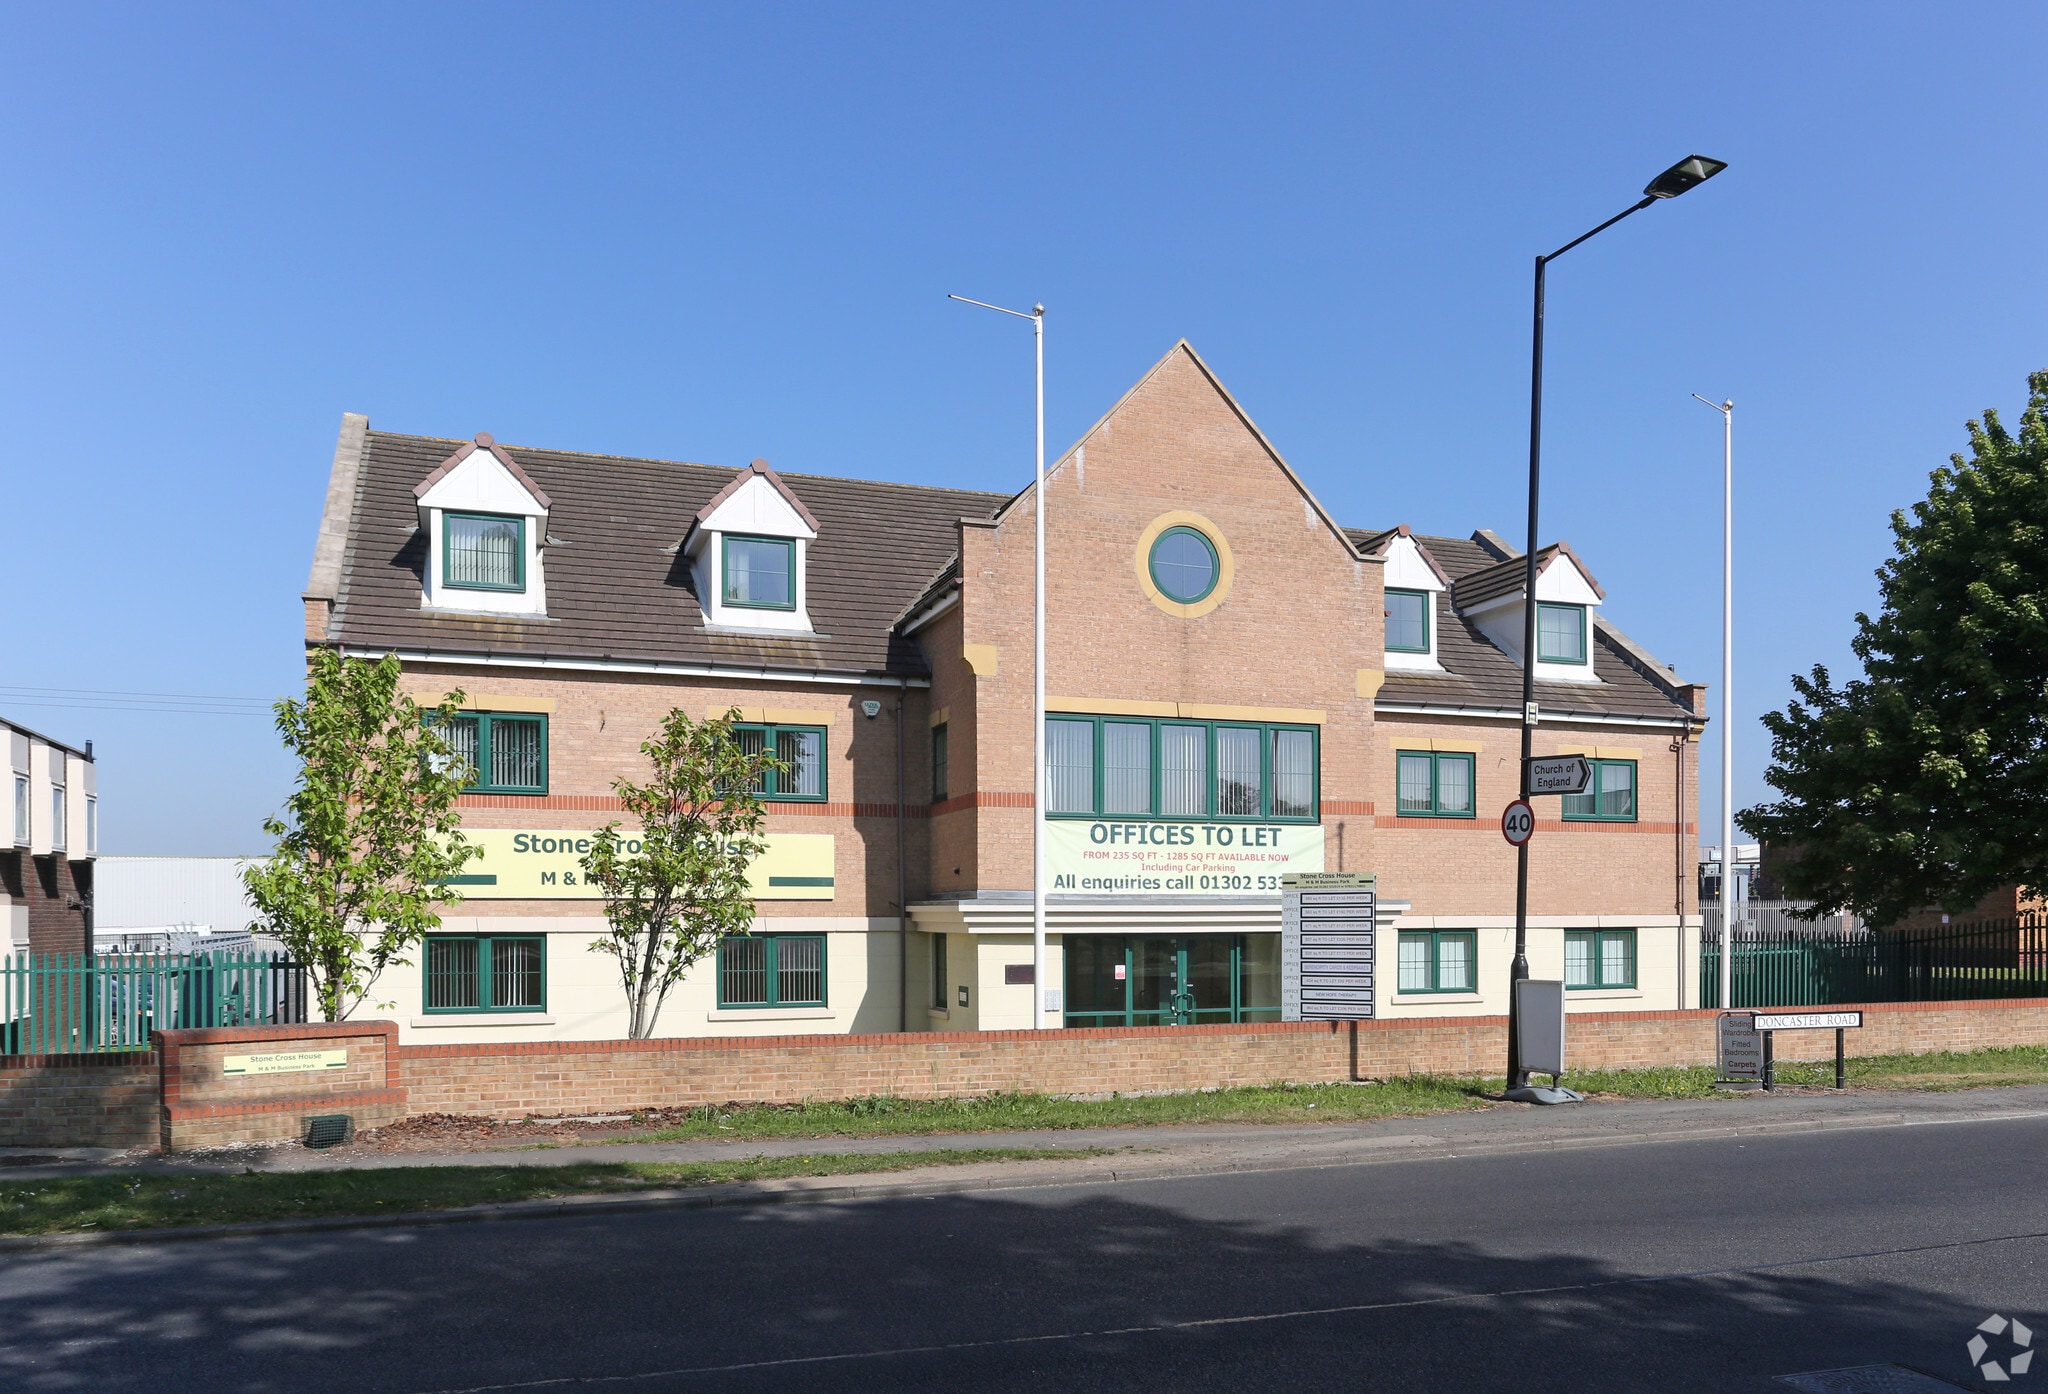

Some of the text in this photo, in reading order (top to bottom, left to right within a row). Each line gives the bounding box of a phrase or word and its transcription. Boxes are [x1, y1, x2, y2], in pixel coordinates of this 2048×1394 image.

[1534, 762, 1575, 775] Church of
[1537, 776, 1571, 789] England
[1506, 814, 1531, 833] 40
[1090, 823, 1282, 847] OFFICES TO LET
[513, 833, 590, 854] Stone
[1083, 851, 1110, 860] FROM
[1112, 851, 1130, 860] 235
[1132, 851, 1145, 861] SQ
[1147, 852, 1158, 861] FT
[1167, 852, 1189, 861] 1285
[1191, 852, 1203, 863] SQ
[1205, 853, 1216, 862] FT
[1218, 853, 1266, 862] AVAILABLE
[1268, 853, 1290, 862] NOW
[1141, 863, 1236, 874] Including Car Parking
[541, 871, 556, 886] M
[563, 871, 578, 886] &
[1054, 874, 1076, 889] All
[1081, 875, 1161, 893] enquiries
[1165, 875, 1194, 890] call
[1199, 875, 1252, 890] 01302
[1729, 1021, 1752, 1029] Sliding
[1757, 1014, 1857, 1028] DONCASTER ROAD
[275, 1054, 297, 1062] Cross
[1728, 1061, 1757, 1069] Carpets
